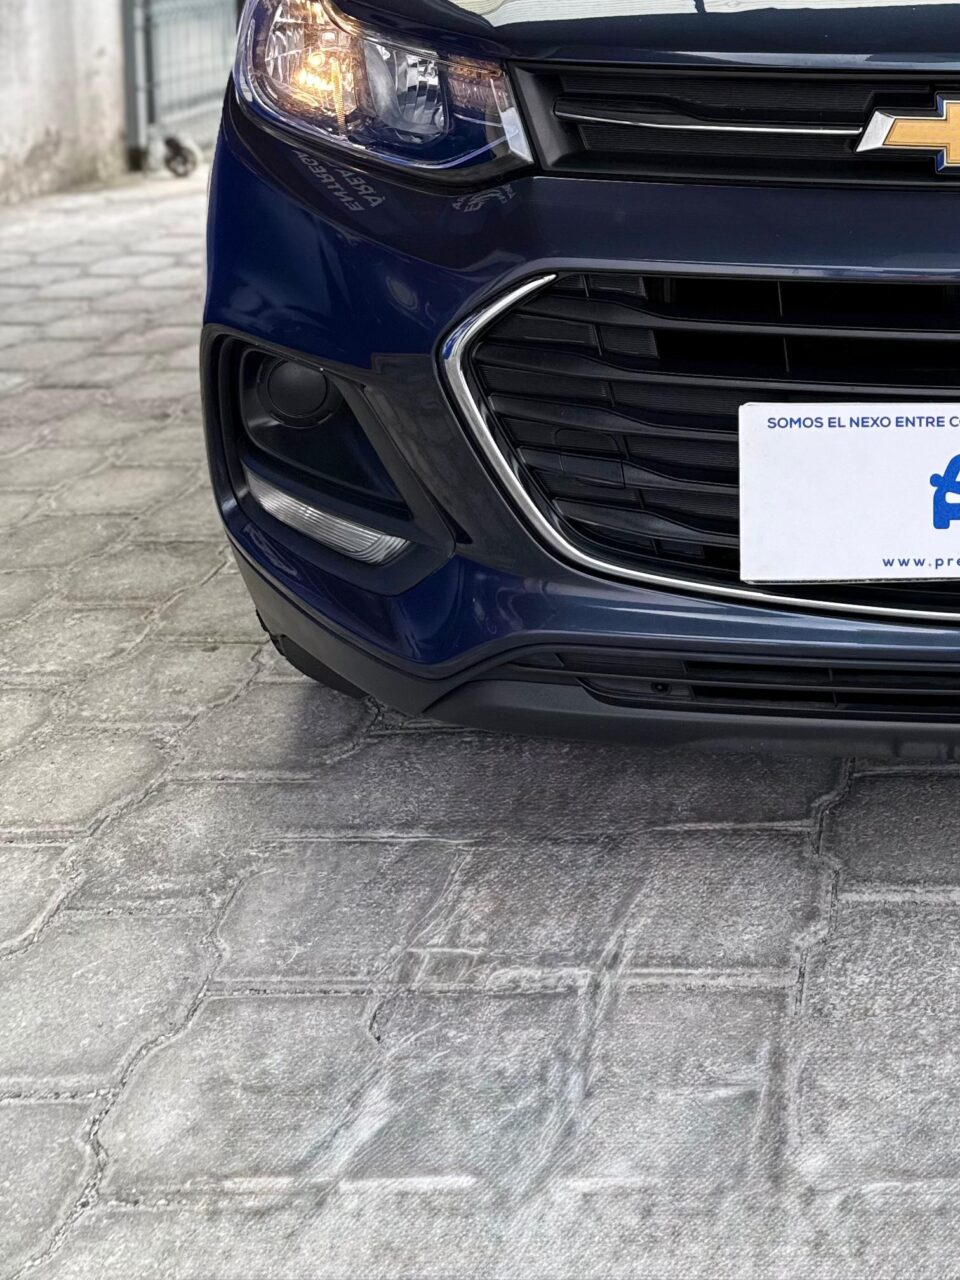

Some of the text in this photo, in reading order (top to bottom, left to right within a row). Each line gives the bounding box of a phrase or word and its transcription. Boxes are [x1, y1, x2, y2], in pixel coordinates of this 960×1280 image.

[767, 415, 824, 429] SOMOS
[827, 415, 847, 429] EL
[849, 415, 892, 429] NEXO
[895, 415, 946, 429] ENTRE
